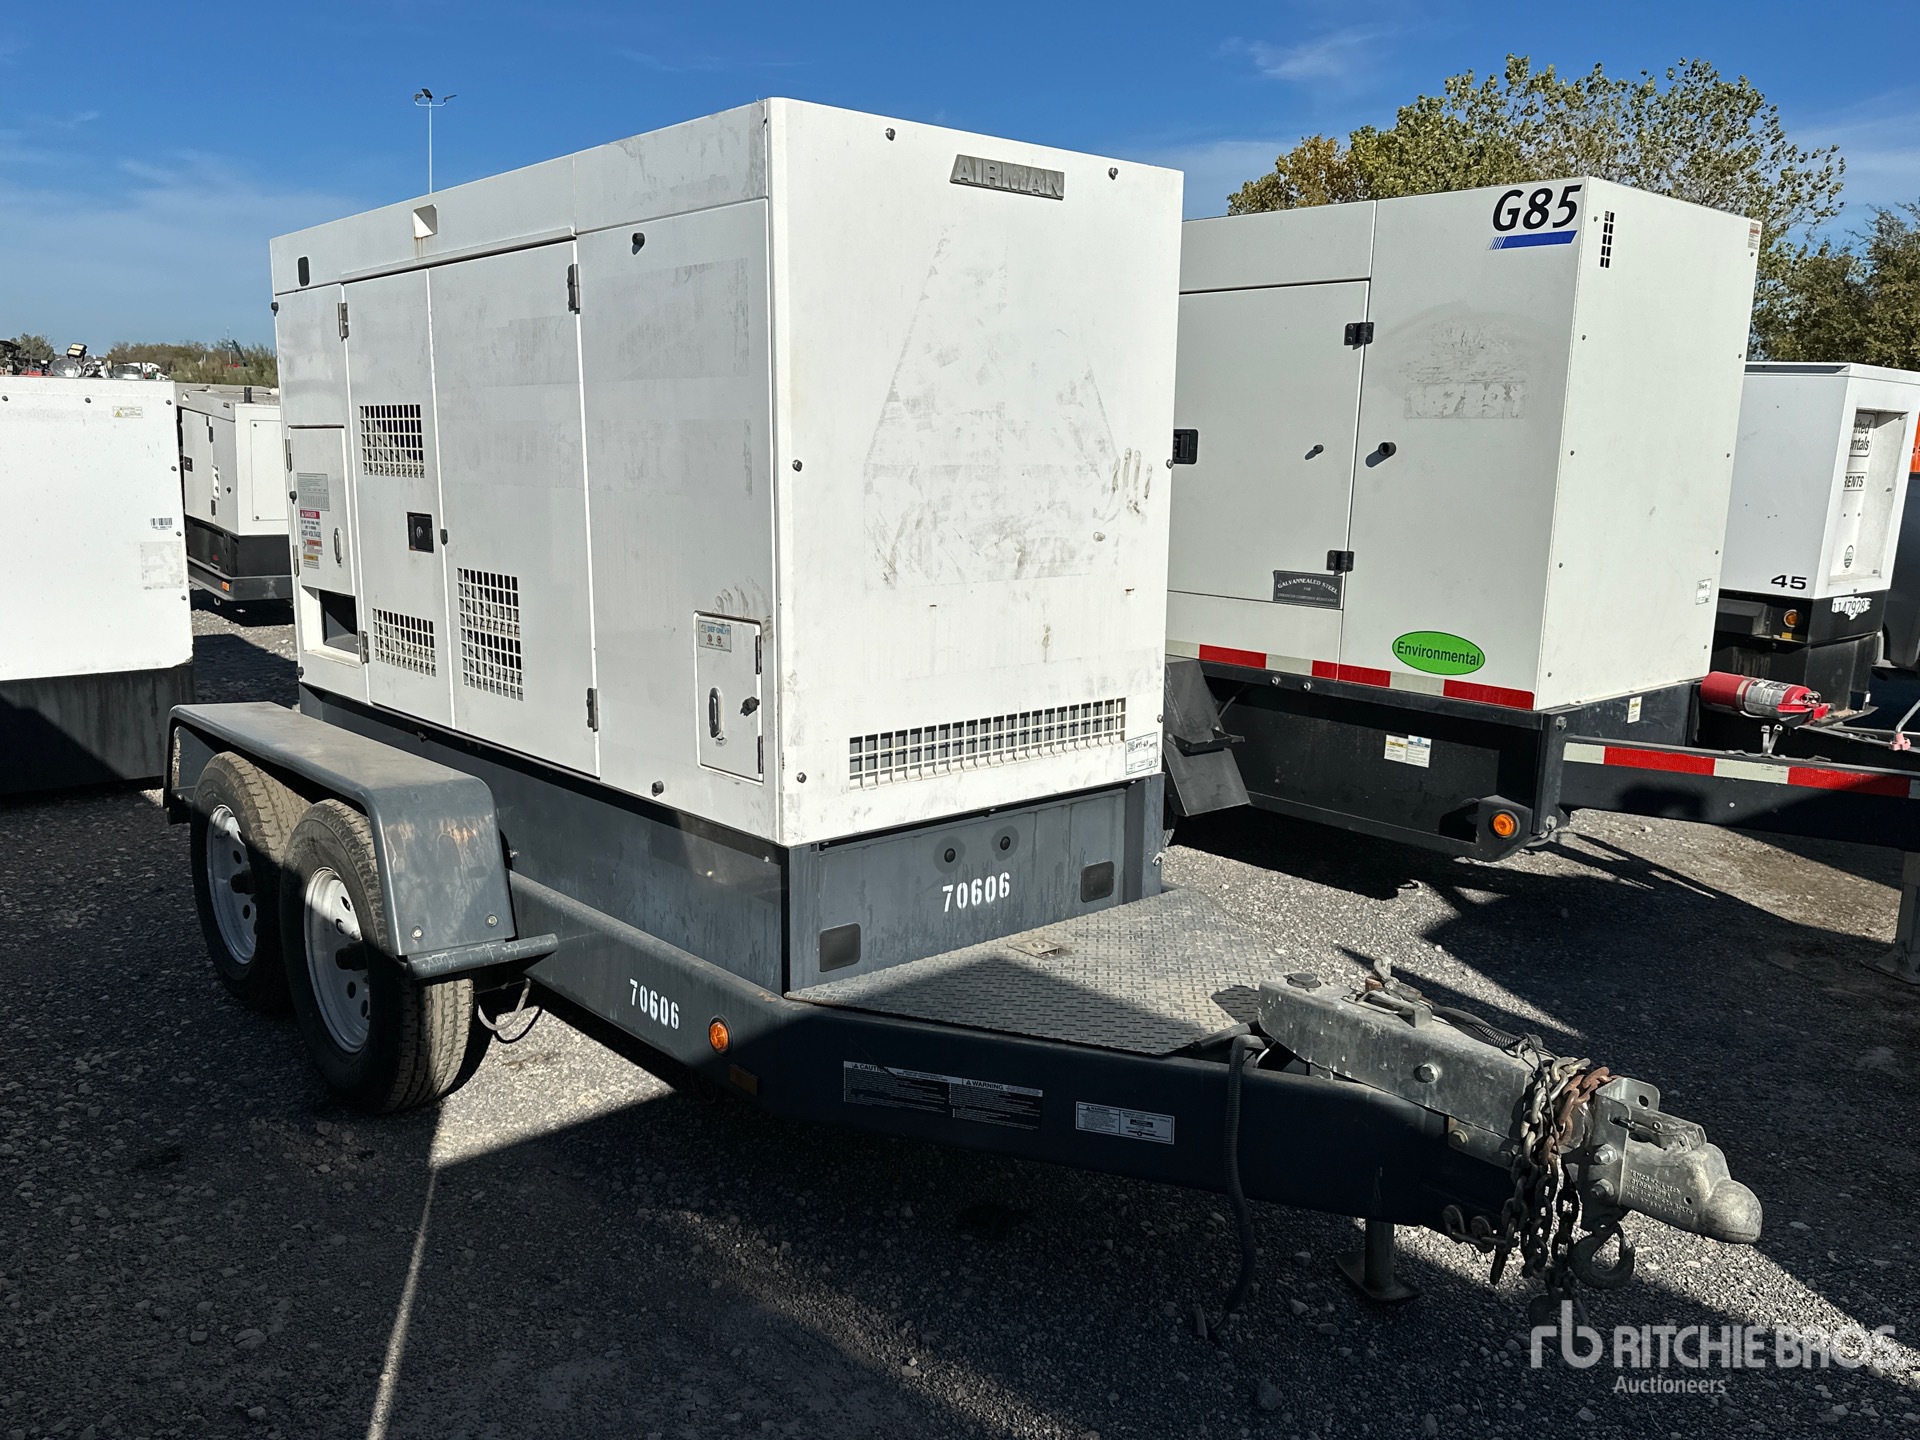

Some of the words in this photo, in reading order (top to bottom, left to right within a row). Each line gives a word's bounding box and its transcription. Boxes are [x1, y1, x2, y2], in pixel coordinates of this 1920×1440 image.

[952, 155, 1065, 197] AIRMAN
[1492, 184, 1583, 232] G85
[1277, 578, 1321, 589] GALVANNEALED
[1321, 582, 1338, 595] STEEL
[1770, 574, 1807, 591] 45
[1396, 640, 1481, 667] Environmental
[941, 871, 1012, 913] 70606
[628, 978, 680, 1031] 70606
[971, 1080, 1004, 1090] WARNING
